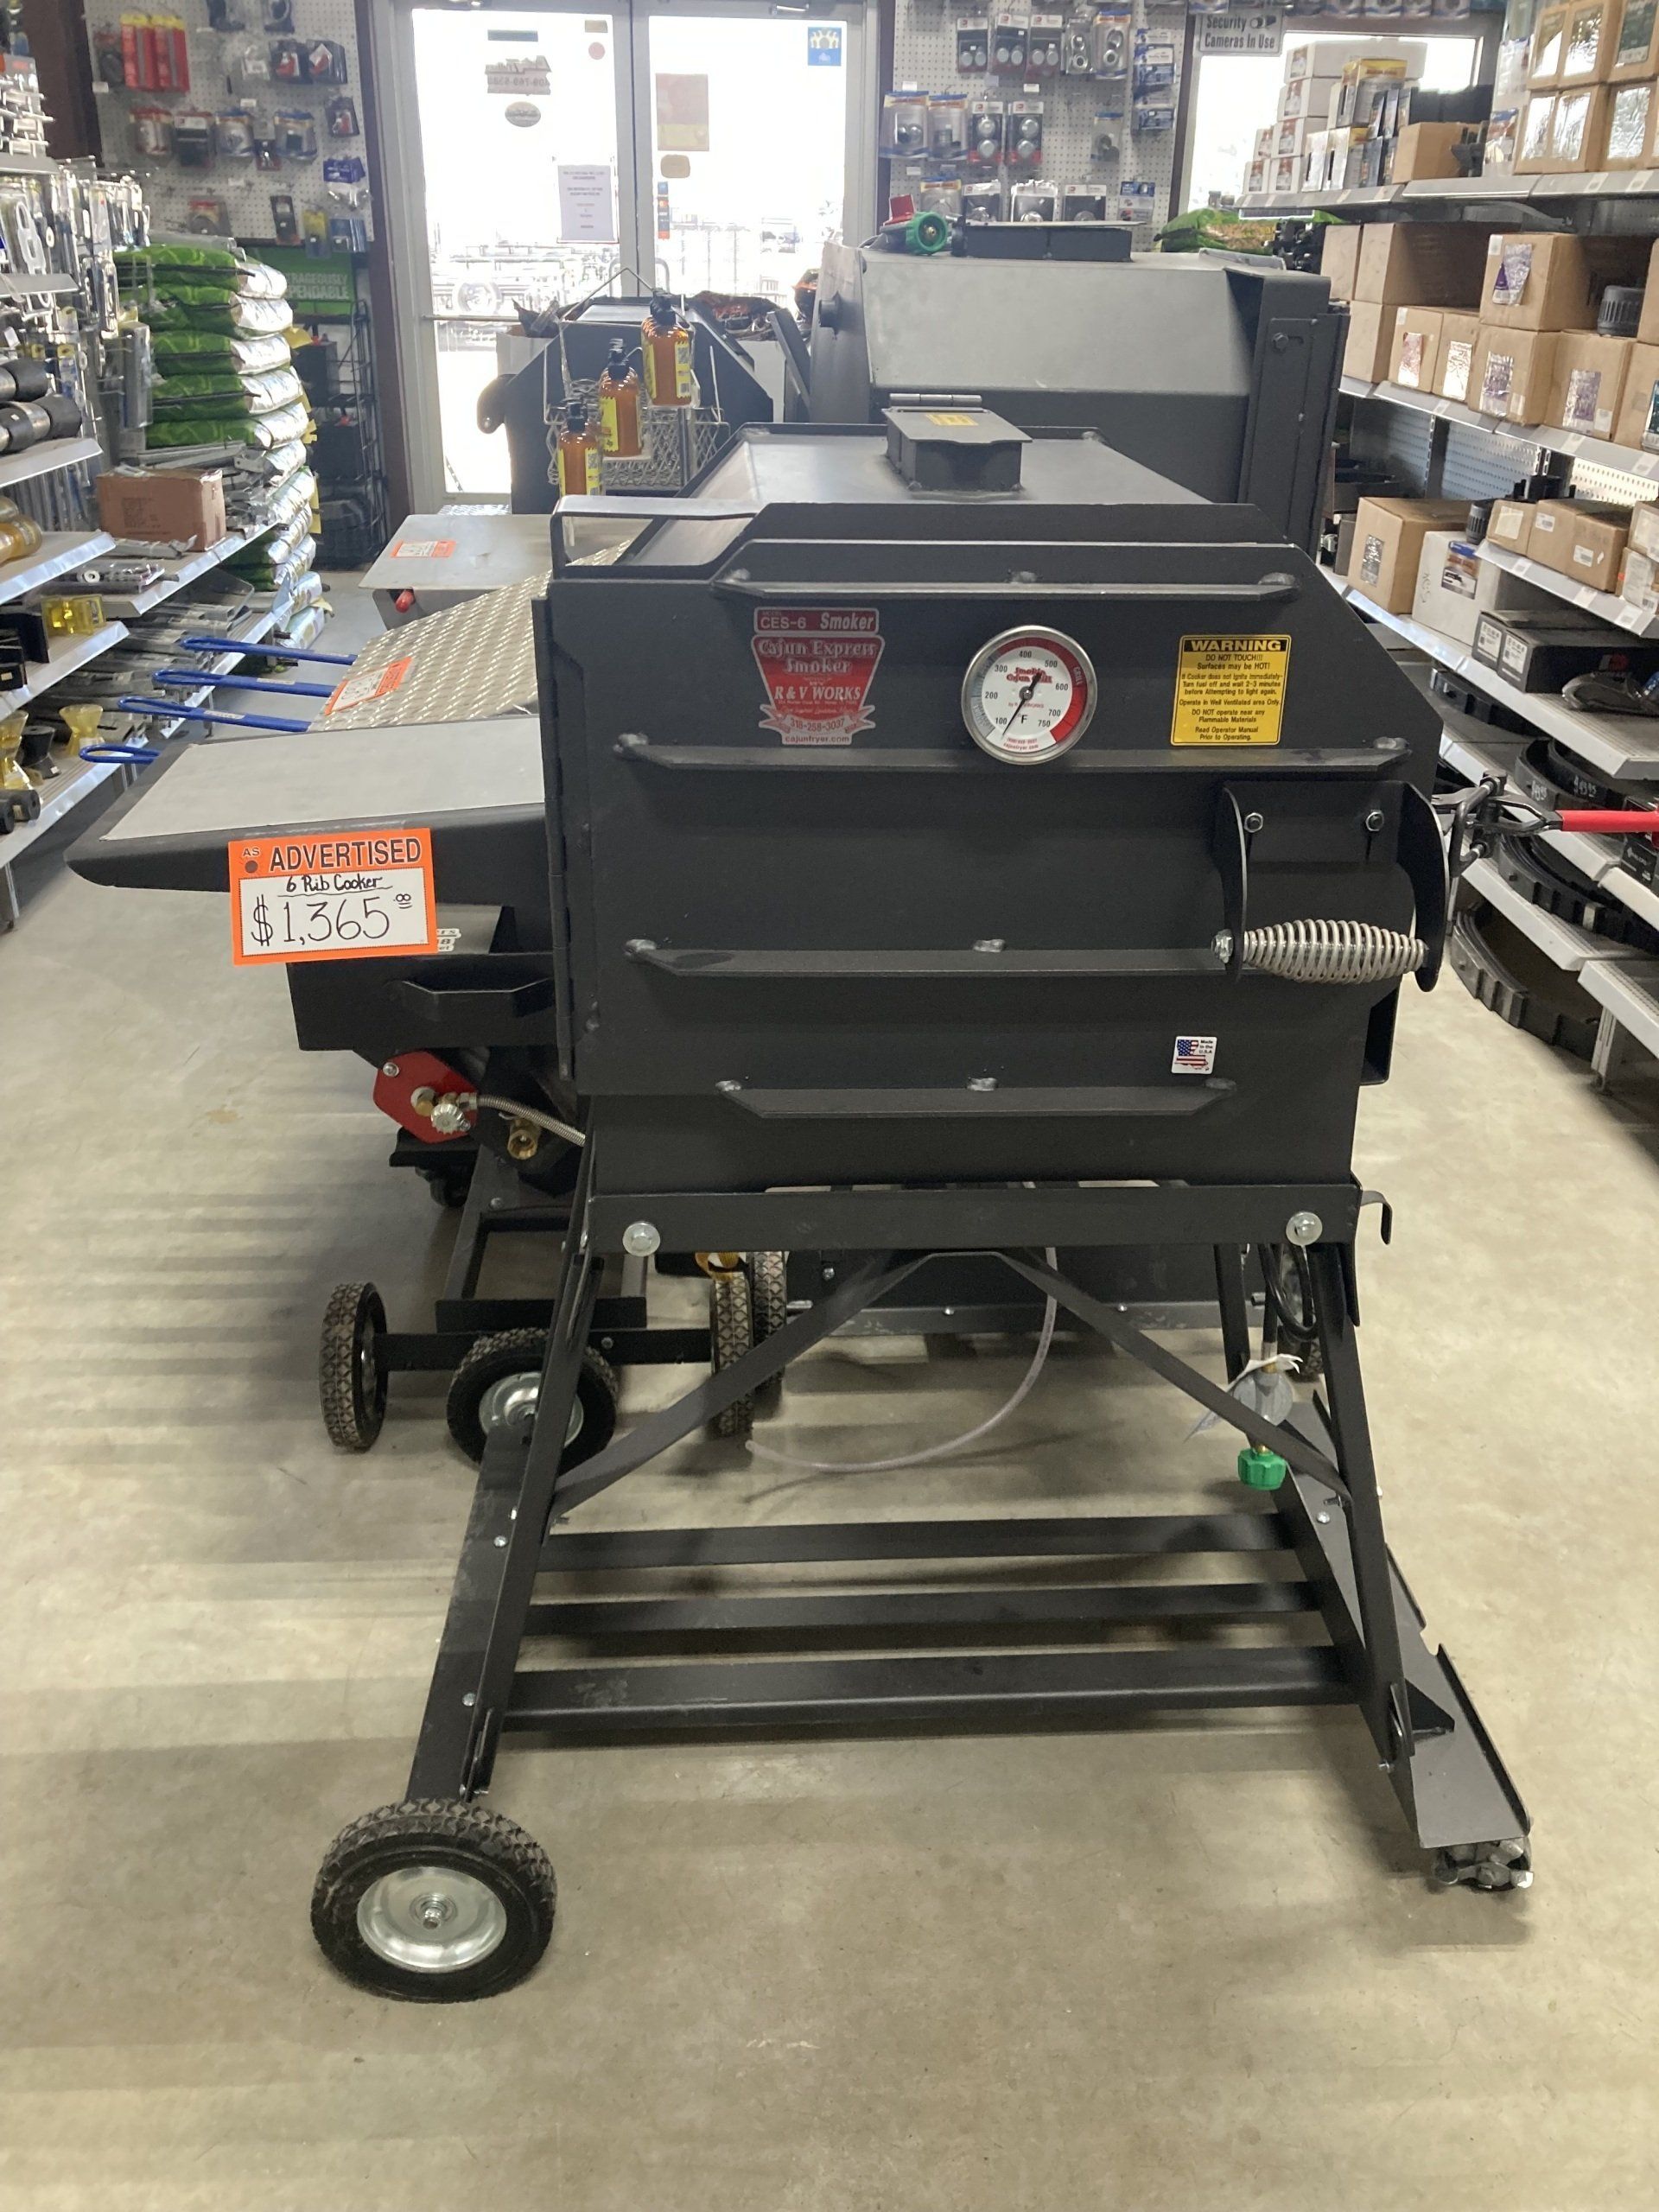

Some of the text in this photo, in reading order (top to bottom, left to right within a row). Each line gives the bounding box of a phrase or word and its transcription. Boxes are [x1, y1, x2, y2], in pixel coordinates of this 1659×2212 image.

[1206, 14, 1246, 32] Security
[1205, 33, 1275, 48] Cameras In Use
[760, 612, 874, 630] CES-6 Smoker
[759, 638, 877, 658] Cajun Express
[1191, 639, 1281, 652] WARNING
[785, 658, 851, 674] Smoker
[995, 664, 1007, 673] 300
[1045, 659, 1058, 668] 500
[774, 686, 861, 701] R & V WORKS
[785, 735, 850, 744] cajunfryer.com
[243, 837, 422, 872] AS ADVERTISED
[286, 873, 383, 893] 6 Rib Cooker
